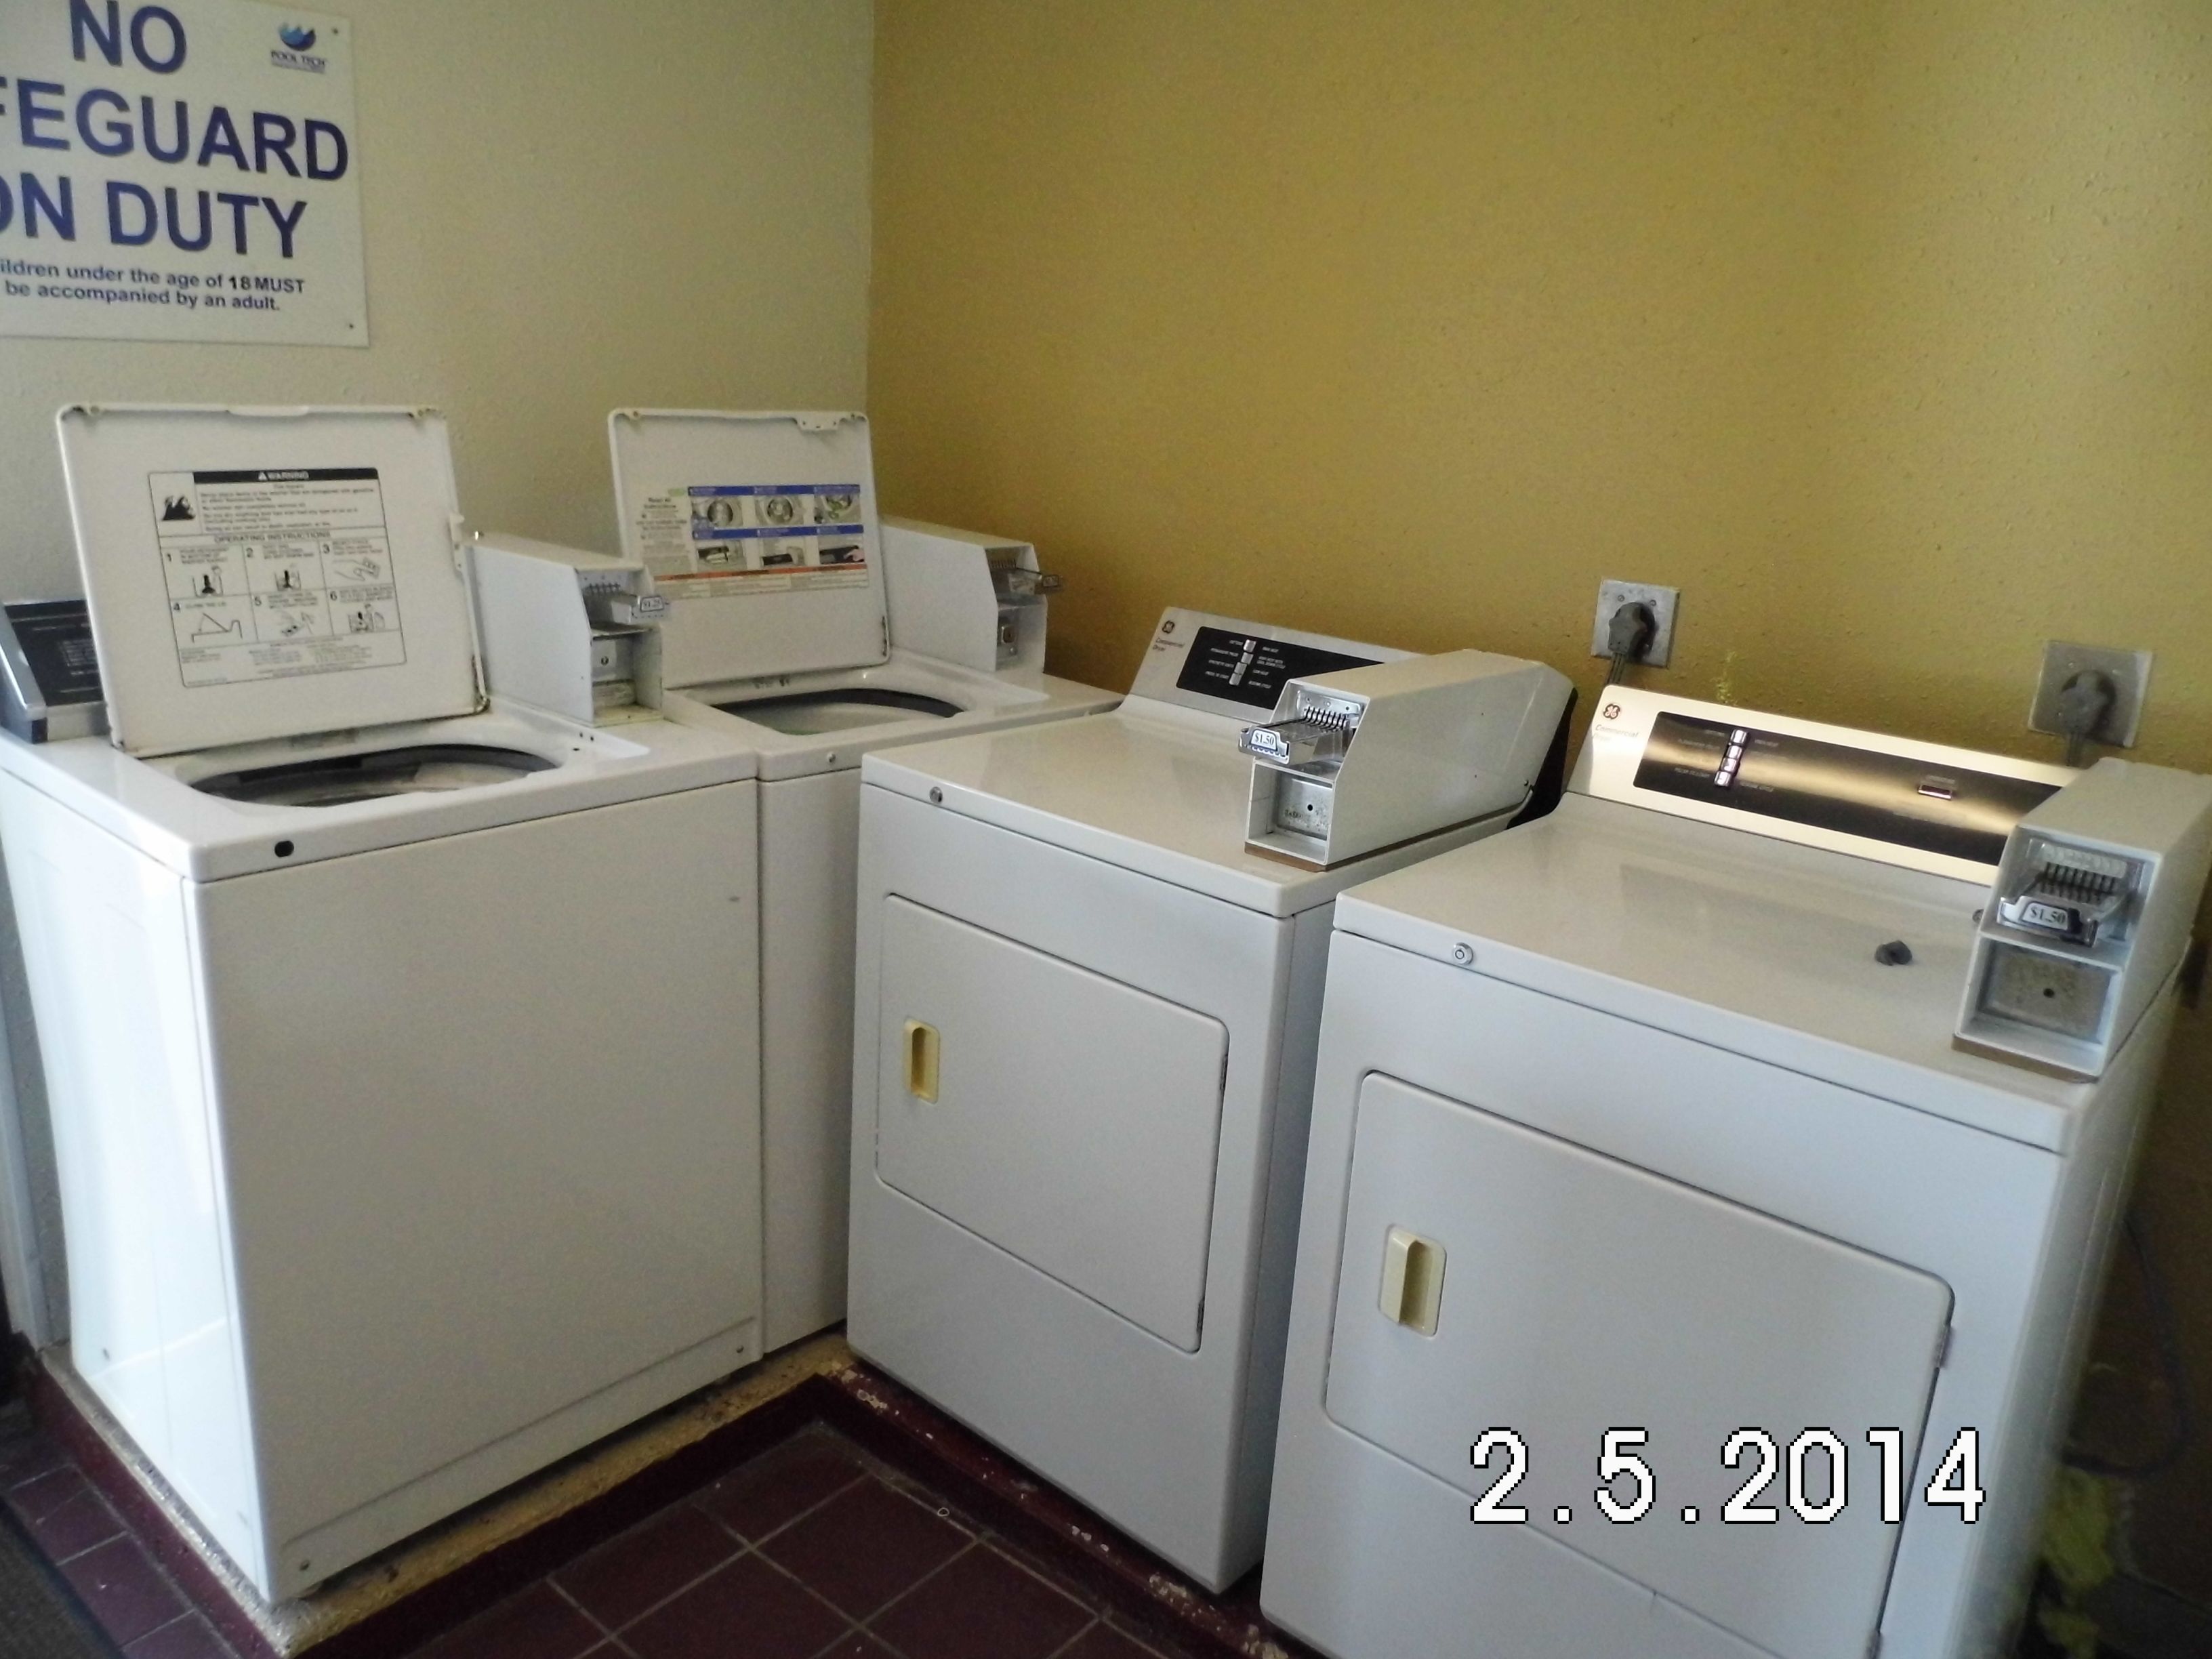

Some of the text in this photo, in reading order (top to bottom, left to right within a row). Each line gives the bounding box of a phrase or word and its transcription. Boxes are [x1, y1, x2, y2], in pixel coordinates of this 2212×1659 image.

[70, 0, 186, 74] NO
[0, 75, 348, 182] EGUARD
[0, 171, 308, 259] N DUTY
[66, 264, 125, 282] under
[131, 268, 161, 285] the
[167, 273, 200, 289] age
[205, 273, 223, 287] of
[228, 276, 251, 290] 18
[254, 276, 304, 293] MUST
[5, 280, 280, 310] be accompanied by an adult.
[268, 470, 310, 481] WARNING
[1254, 733, 1275, 745] $1.50
[1595, 724, 1640, 739] Commercial
[2030, 907, 2066, 924] $1.50
